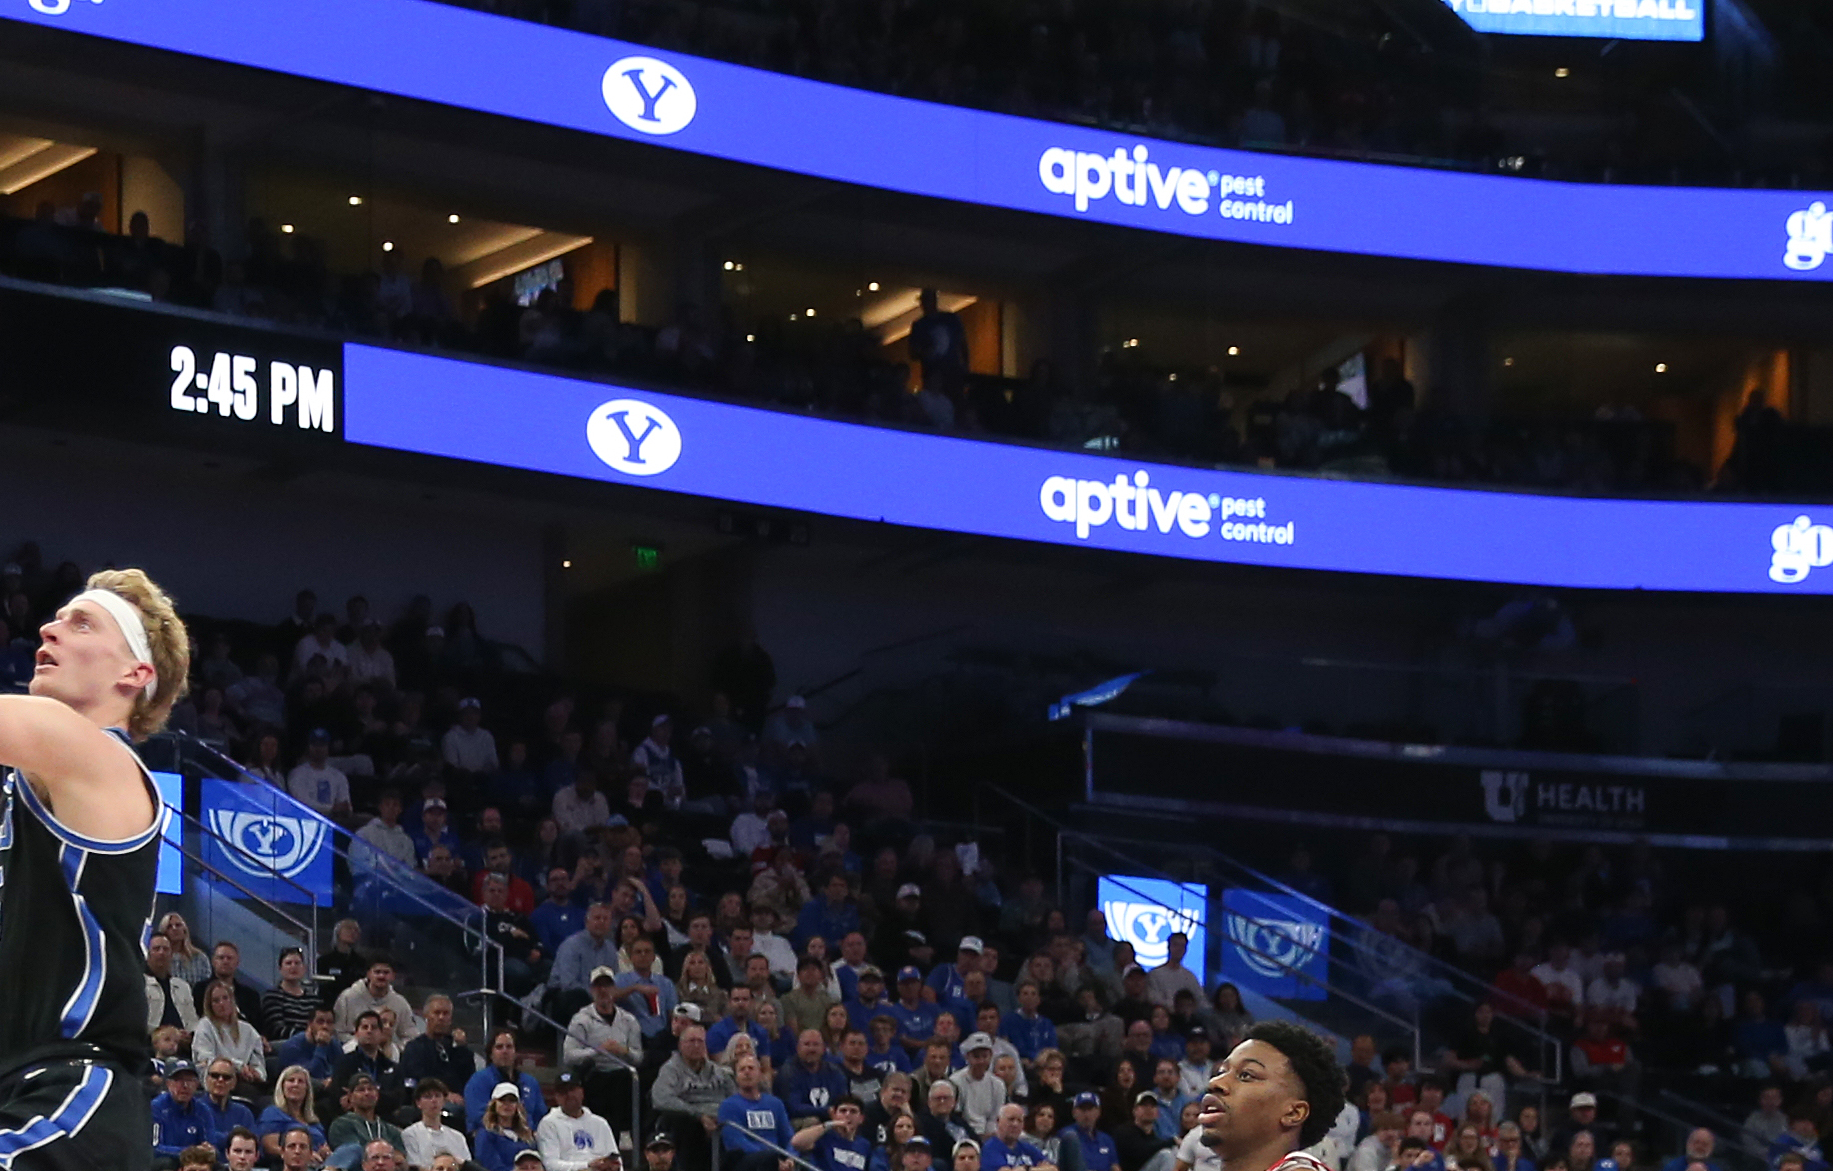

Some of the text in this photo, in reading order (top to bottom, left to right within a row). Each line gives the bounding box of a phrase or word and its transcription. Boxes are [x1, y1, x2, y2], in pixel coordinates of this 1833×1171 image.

[621, 68, 678, 123] Y
[1038, 144, 1266, 215] aptive pest
[1219, 199, 1293, 225] control
[170, 346, 334, 433] 2:45 PM
[606, 410, 663, 465] Y
[1039, 469, 1267, 539] aptive pest
[1221, 521, 1295, 546] control
[1537, 783, 1645, 812] HEALTH
